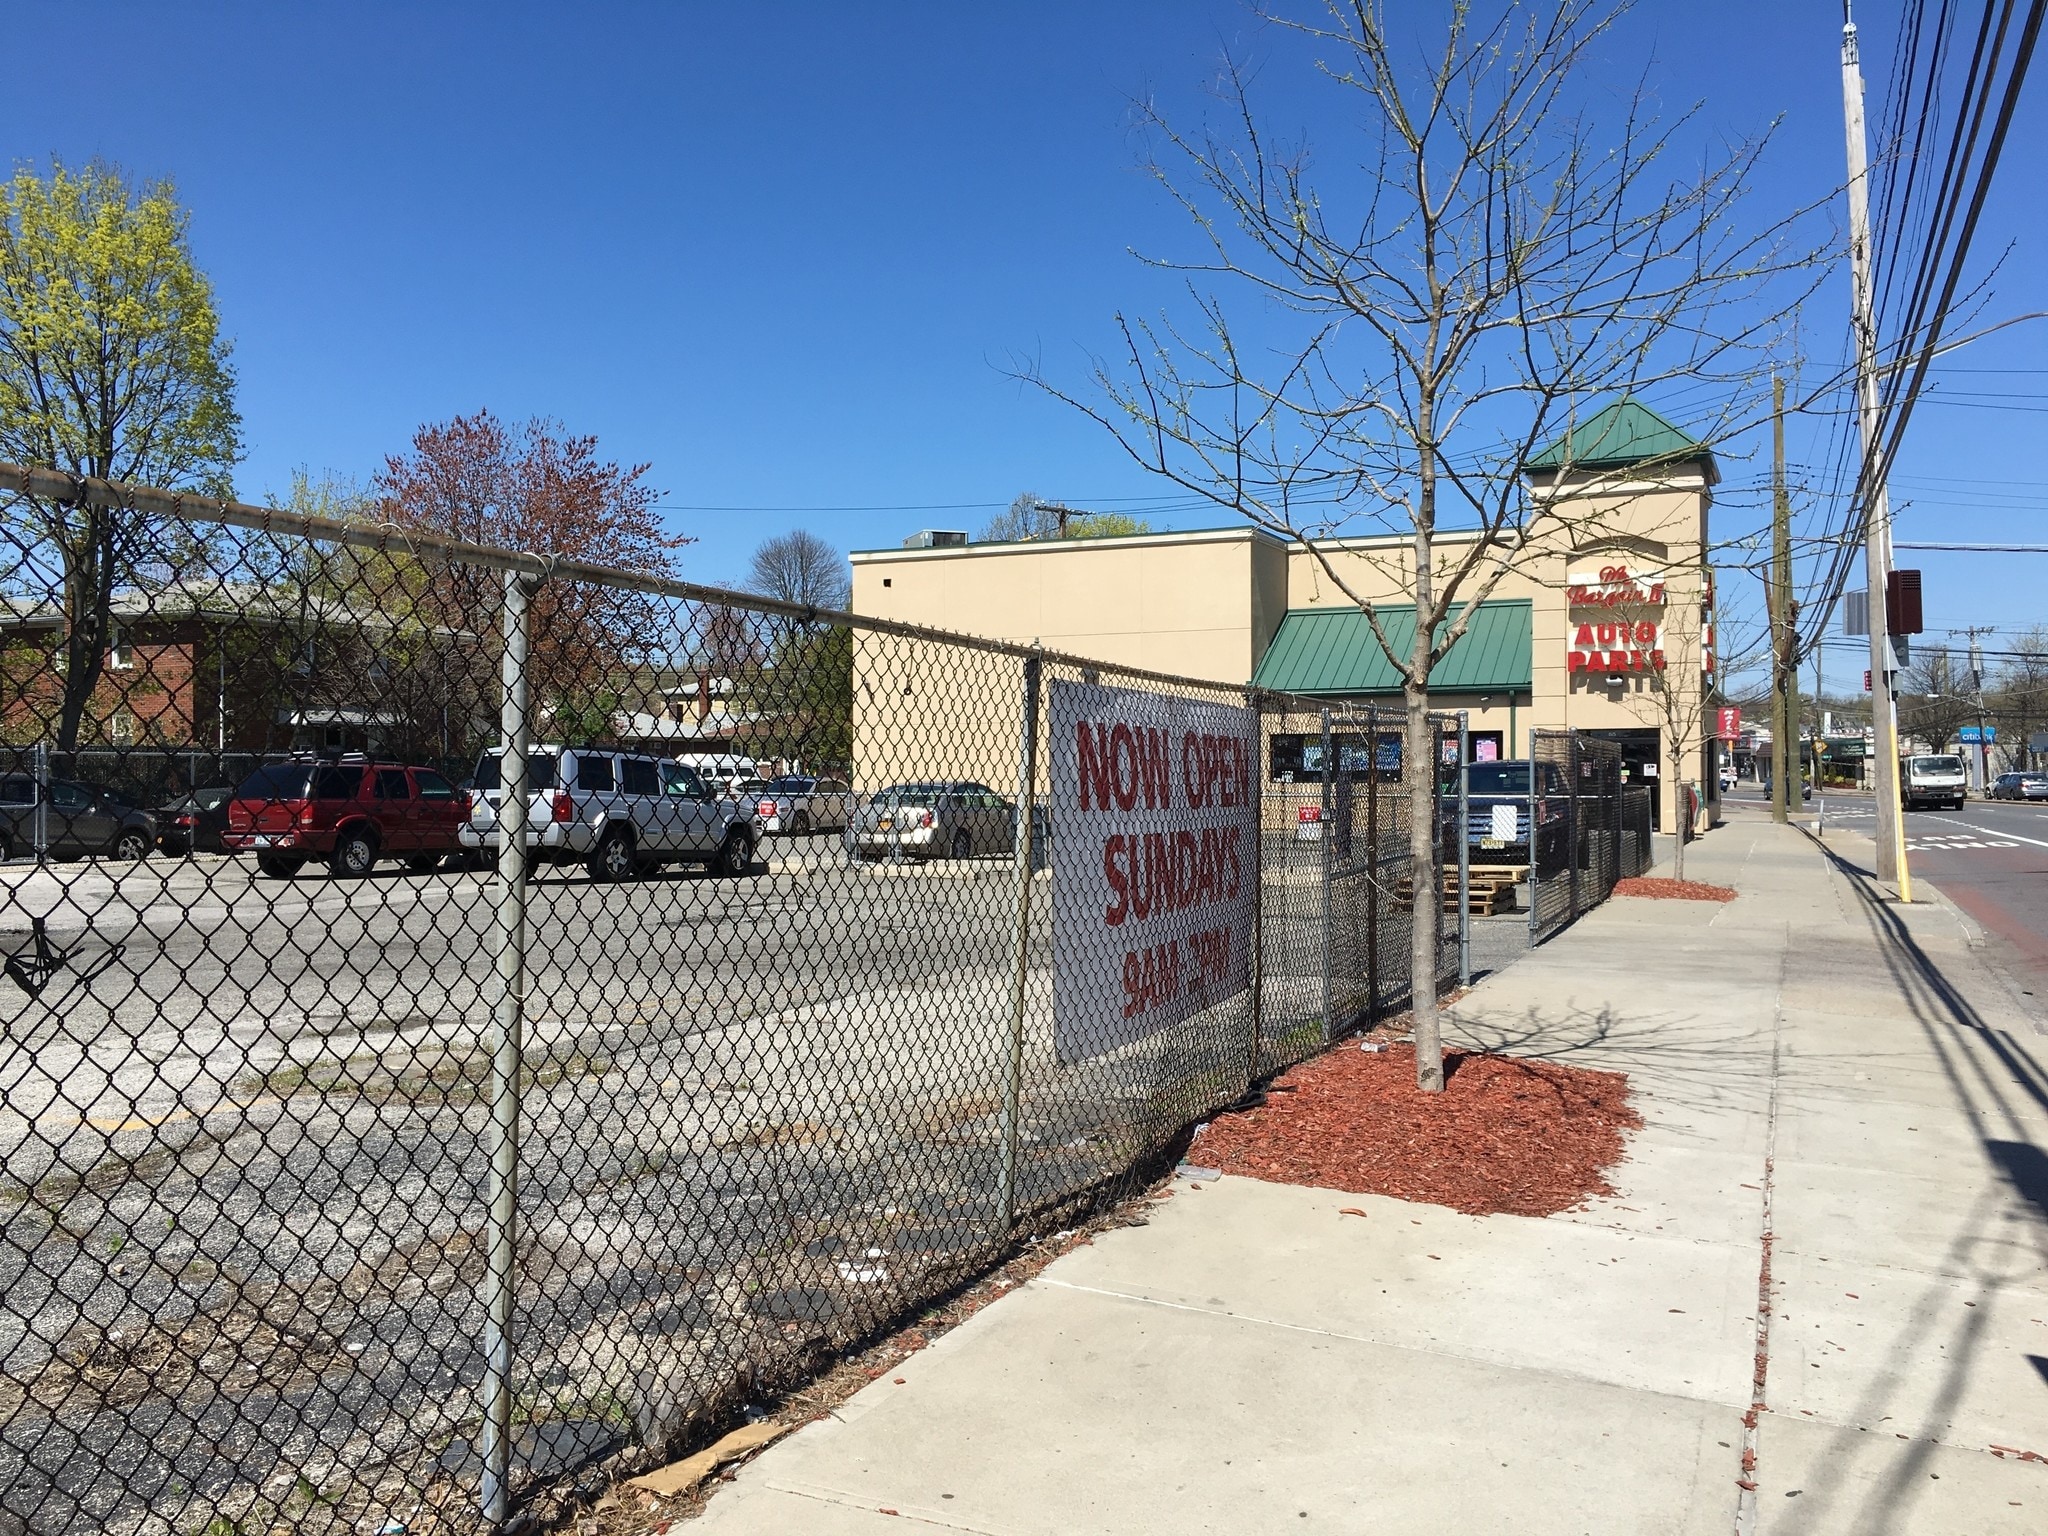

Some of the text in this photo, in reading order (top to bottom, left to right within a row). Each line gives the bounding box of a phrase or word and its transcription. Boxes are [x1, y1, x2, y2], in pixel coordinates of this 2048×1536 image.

[1599, 566, 1633, 586] The
[1575, 621, 1657, 646] AUTO
[1568, 649, 1665, 673] PARTS
[1962, 732, 1994, 741] citibnk
[1076, 720, 1250, 812] NOW OPEN
[1904, 841, 2021, 851] ONLY
[1104, 827, 1241, 927] SUNDAYS
